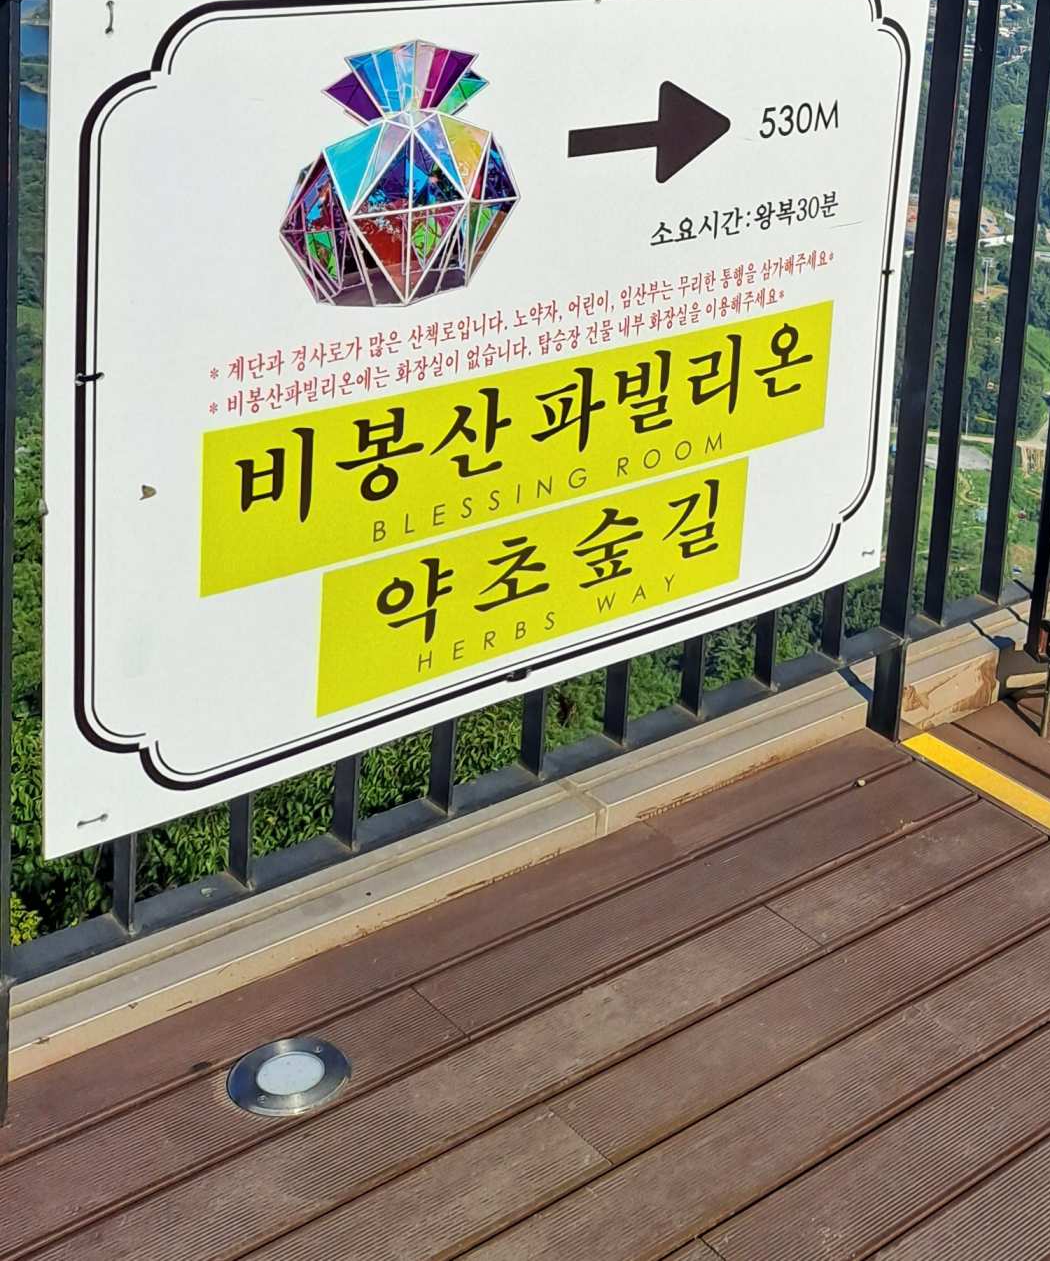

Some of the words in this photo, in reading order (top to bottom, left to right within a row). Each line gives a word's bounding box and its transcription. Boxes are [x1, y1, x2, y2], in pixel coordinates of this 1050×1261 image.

[760, 99, 839, 139] 530M
[227, 350, 284, 382] 계단과
[291, 337, 362, 372] 경사로가
[369, 330, 402, 357] 많은
[408, 311, 508, 348] 산책로입니다.
[514, 302, 563, 329] 노약자,
[568, 291, 615, 320] 어린이,
[620, 280, 674, 309] 임산부는
[678, 270, 715, 297] 무리한
[720, 262, 757, 289] 통행을
[227, 366, 391, 416] 비봉산파빌리온에는
[396, 349, 460, 383] 화장실이
[466, 337, 532, 371] 없습니다.
[538, 328, 580, 356] 탑승장
[586, 318, 614, 346] 건물
[618, 312, 645, 338] 내부
[650, 301, 702, 332] 화장실을
[372, 468, 588, 543] BLESSING
[617, 432, 722, 477] ROOM
[418, 611, 555, 673] HERBS
[597, 574, 676, 614] WAY
